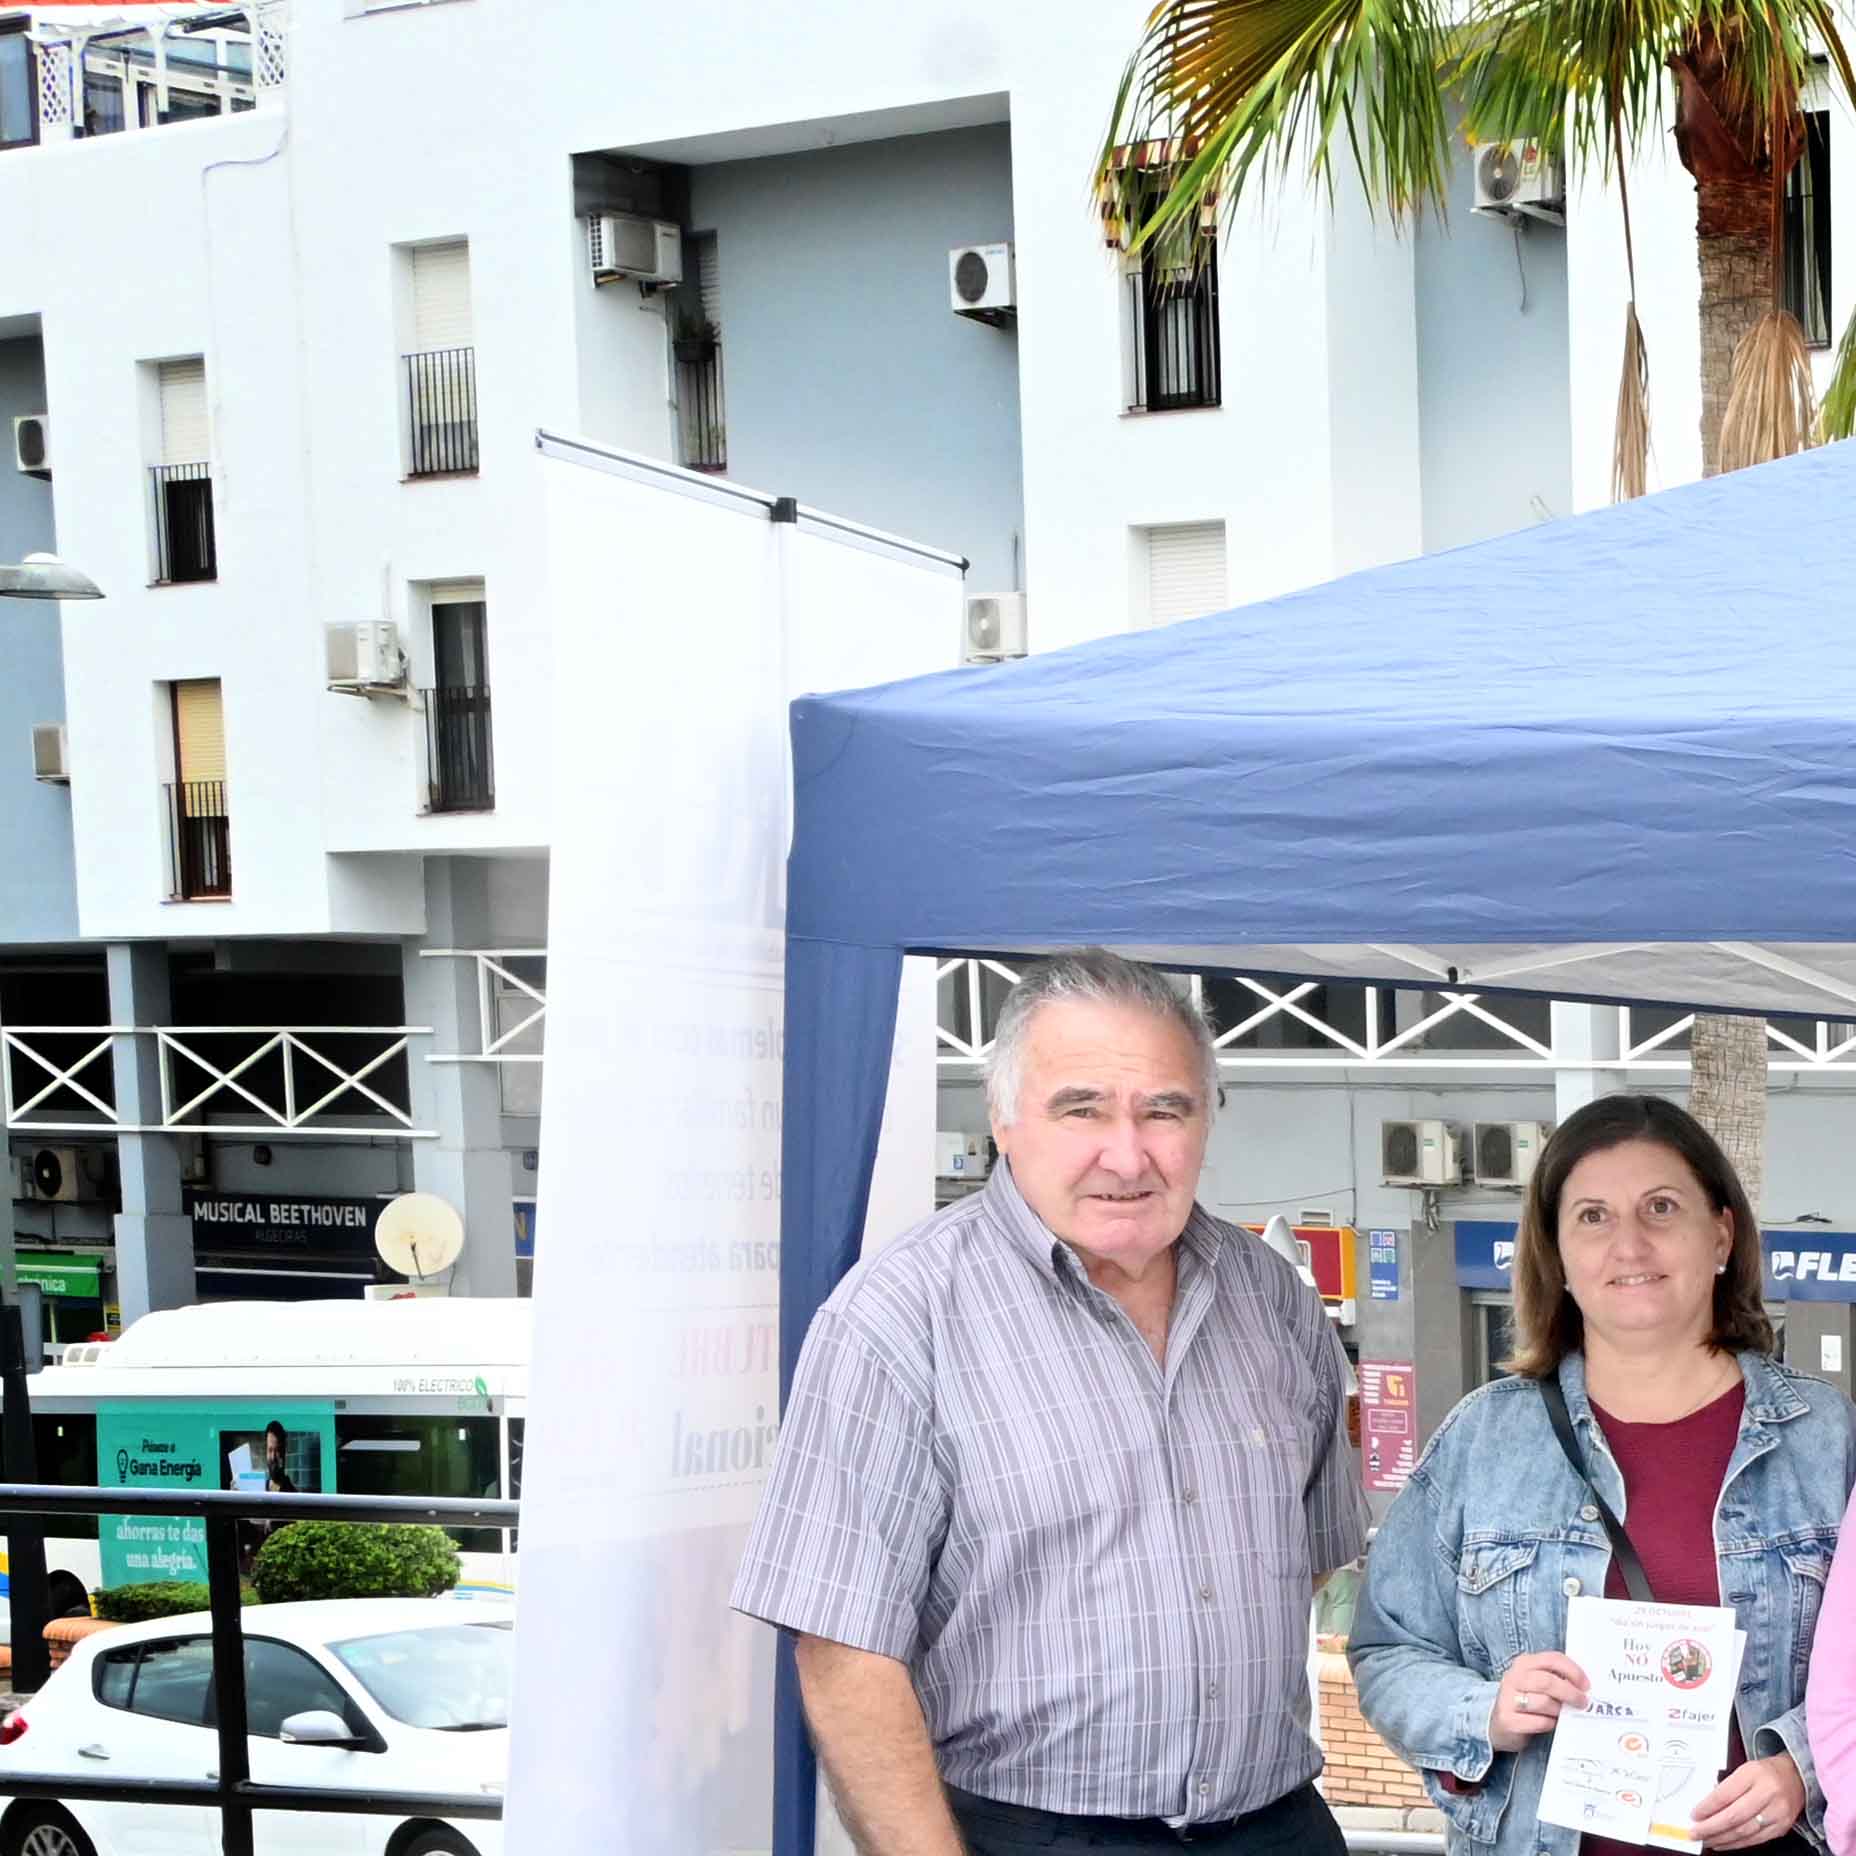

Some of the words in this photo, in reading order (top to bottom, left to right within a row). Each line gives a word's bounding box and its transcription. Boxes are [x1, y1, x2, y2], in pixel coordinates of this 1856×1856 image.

[194, 1201, 266, 1223] MUSICAL
[269, 1203, 367, 1227] BEETHOVEN
[130, 1459, 158, 1477] Gana
[159, 1457, 202, 1482] Energía
[116, 1519, 166, 1541] ahorras
[167, 1522, 180, 1541] te
[182, 1518, 204, 1542] das
[126, 1552, 150, 1569] una
[1623, 1637, 1651, 1653] Hoy
[1625, 1653, 1649, 1666] NO
[1607, 1669, 1664, 1684] Apuesto
[1682, 1707, 1716, 1723] fajer
